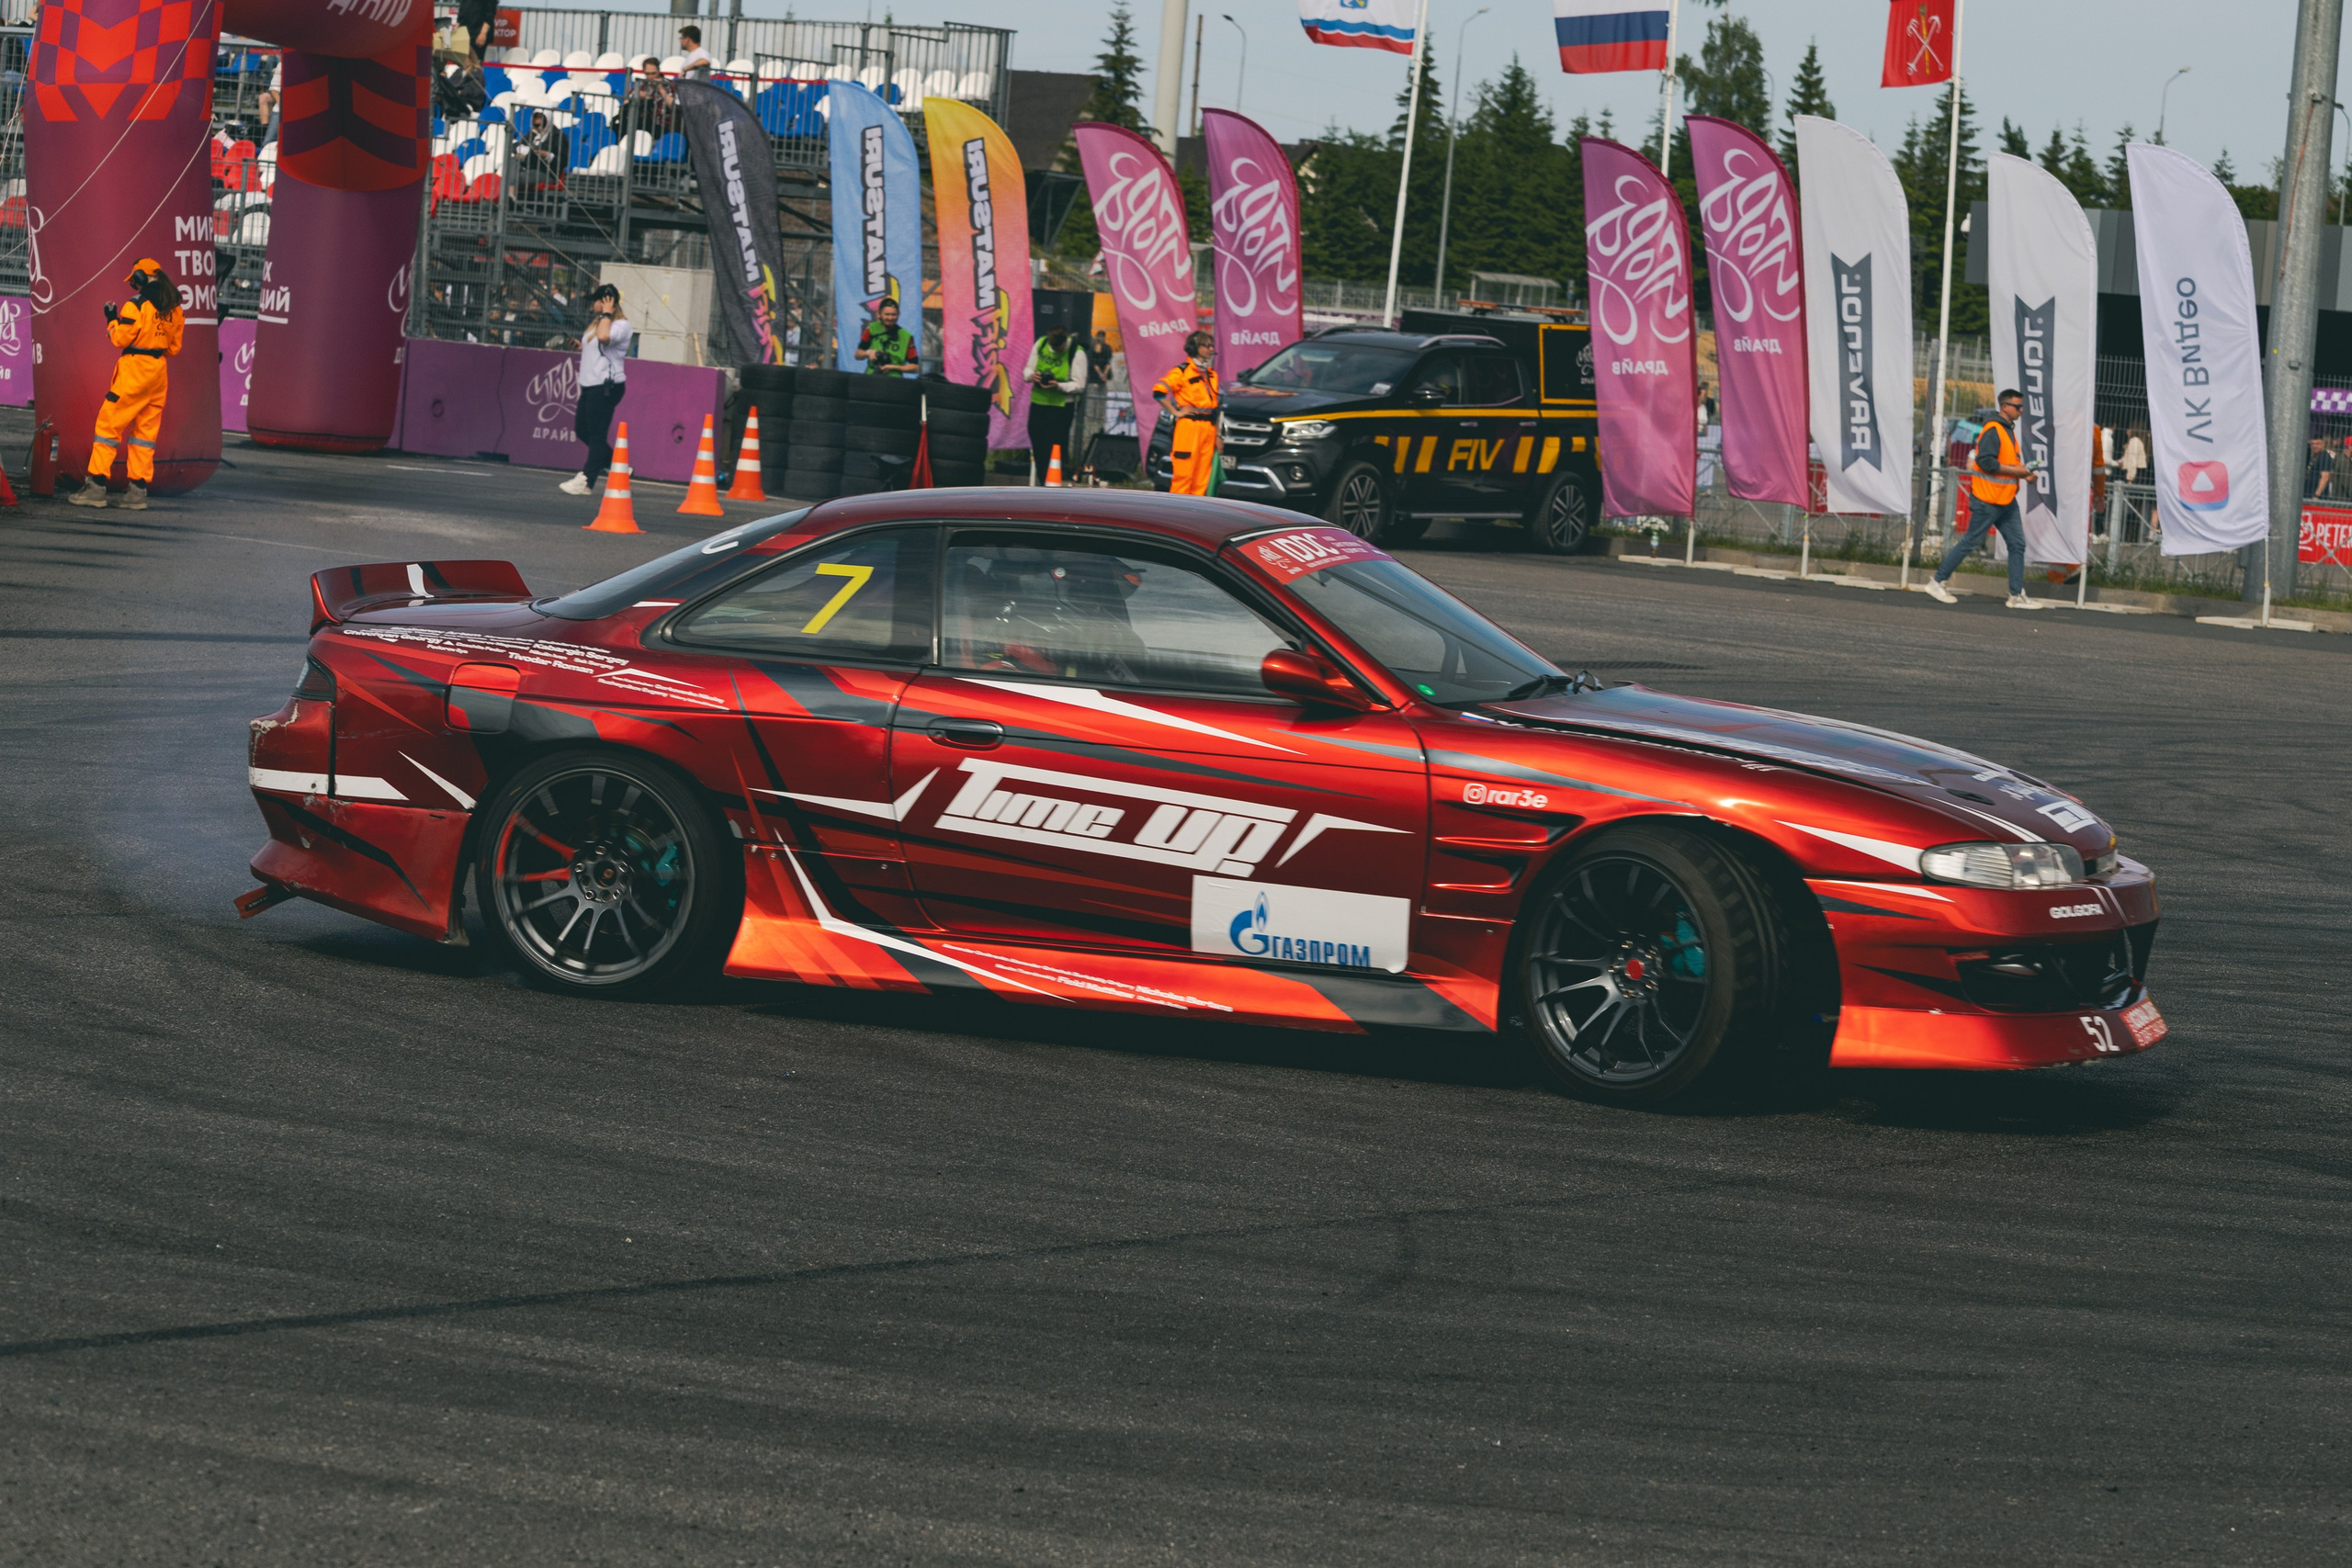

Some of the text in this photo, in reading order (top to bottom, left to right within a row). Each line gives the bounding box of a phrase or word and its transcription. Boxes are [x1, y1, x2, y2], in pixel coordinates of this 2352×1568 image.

[494, 28, 516, 37] КТОР
[175, 250, 216, 276] ТВО
[533, 427, 576, 442] ДРАЙВ
[1269, 533, 1340, 563] IDDC
[800, 563, 875, 635] 7
[1272, 936, 1371, 969] ГАЗПРОМ
[2079, 1015, 2121, 1052] 52
